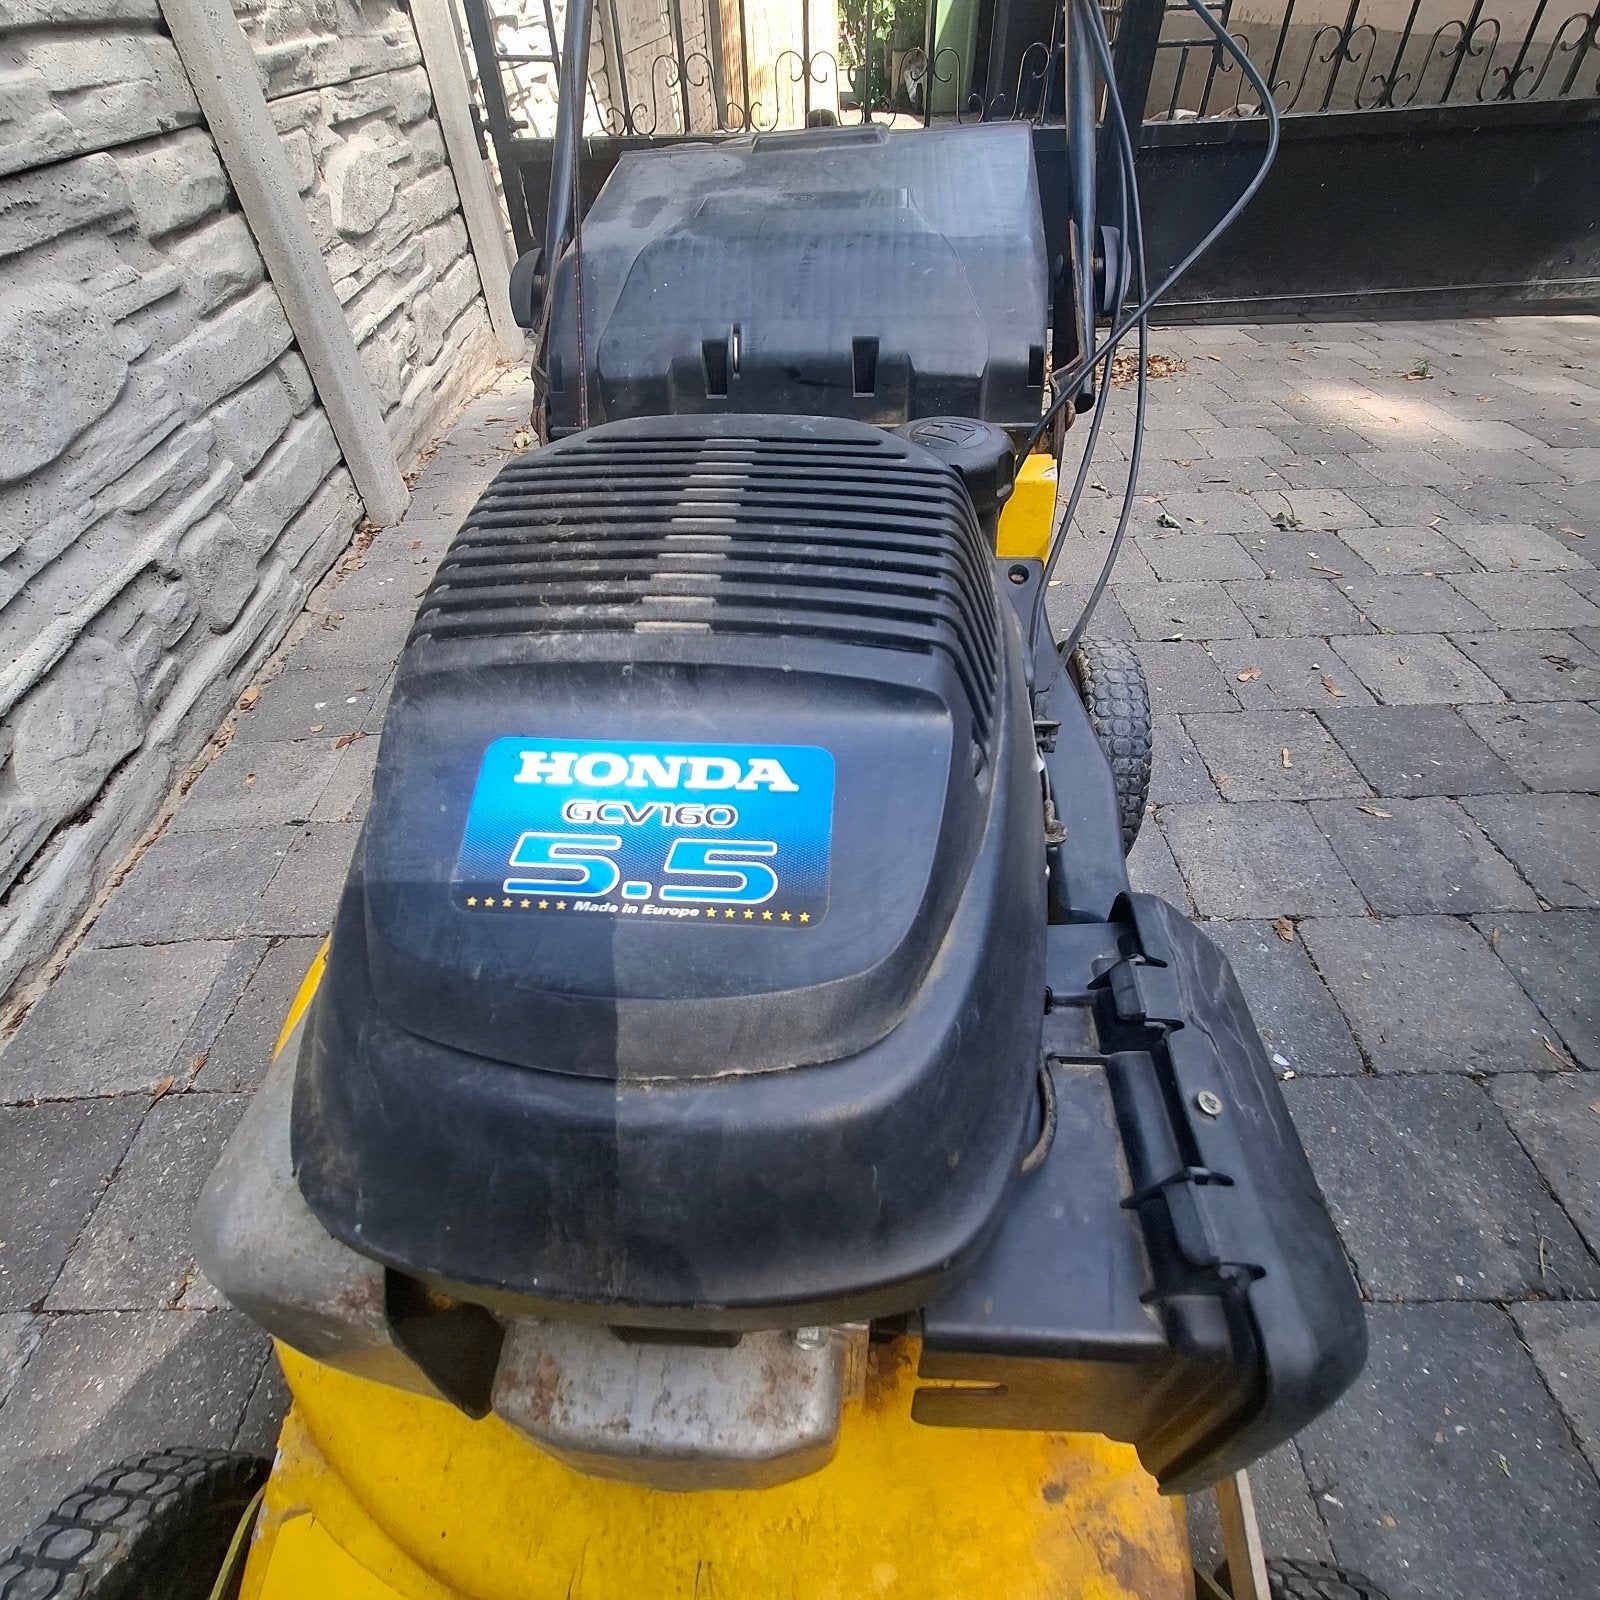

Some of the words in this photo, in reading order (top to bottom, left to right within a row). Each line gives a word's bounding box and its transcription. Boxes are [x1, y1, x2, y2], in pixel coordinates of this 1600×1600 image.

[513, 751, 799, 792] HONDA
[562, 800, 738, 828] GCV160
[503, 831, 778, 904] 5.5
[573, 901, 618, 912] Made
[621, 903, 638, 914] in
[642, 904, 700, 917] Europe
